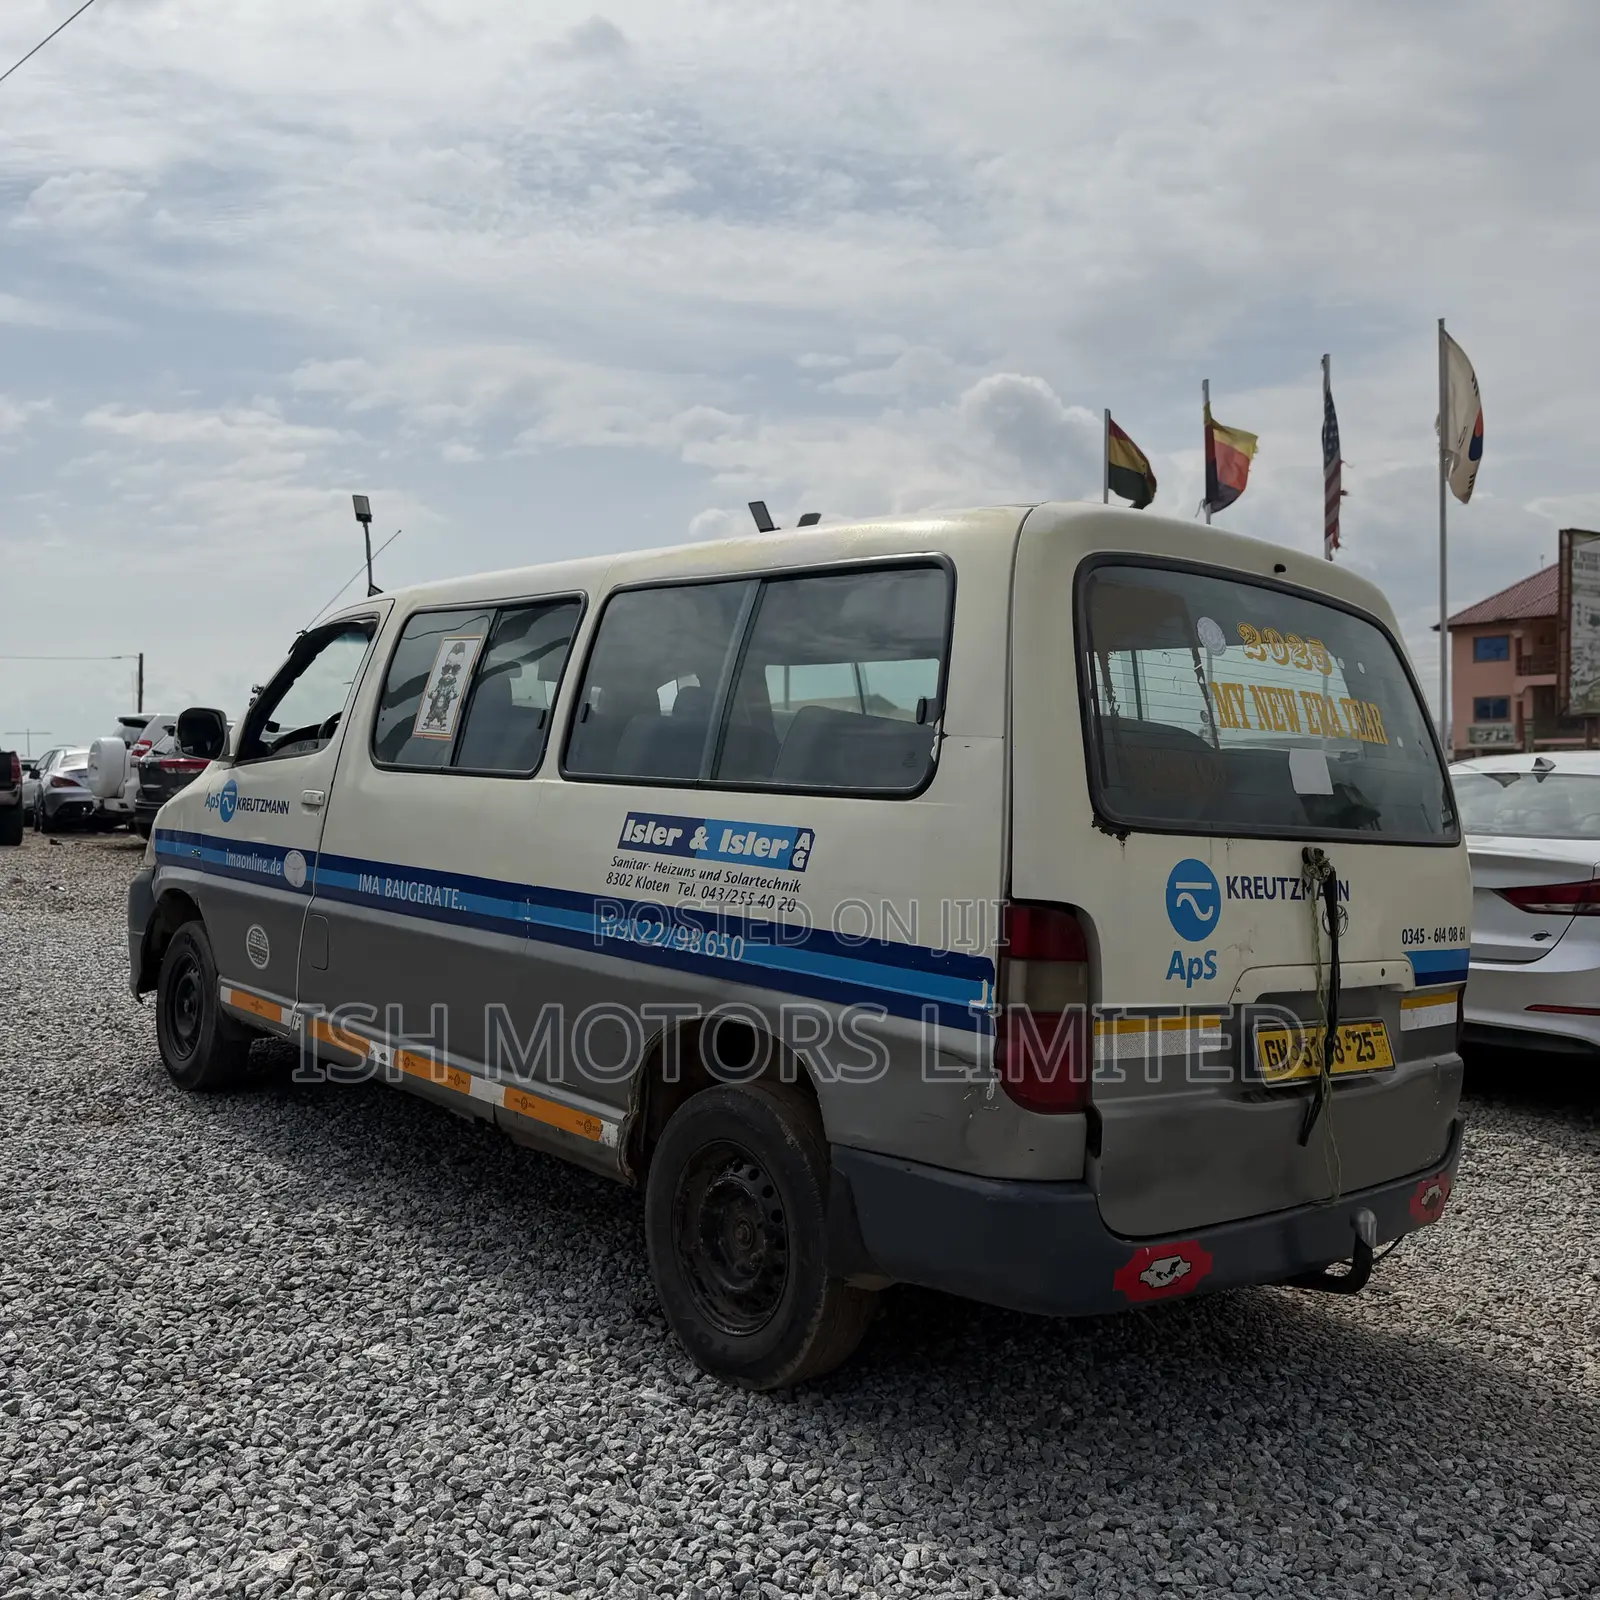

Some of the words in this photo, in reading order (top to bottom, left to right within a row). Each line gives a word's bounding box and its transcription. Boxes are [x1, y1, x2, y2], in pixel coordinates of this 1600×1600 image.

[1237, 621, 1332, 676] 2025
[1210, 682, 1251, 729] MY
[1249, 684, 1300, 733] NEW
[1299, 690, 1347, 738] ERA
[1339, 697, 1388, 745] YEAR
[204, 791, 221, 813] ApS
[237, 796, 290, 816] KREUTZMANN
[621, 819, 684, 847] Isler
[689, 825, 710, 851] &
[718, 828, 790, 859] Isler
[225, 848, 282, 876] imaonline.de
[611, 855, 651, 871] Sanitar-
[653, 861, 697, 878] Heizuns
[698, 869, 723, 882] und
[723, 871, 801, 893] Solartechnik
[358, 873, 380, 896] IMA
[606, 871, 634, 888] 8302
[635, 875, 670, 893] Kloten
[677, 882, 697, 898] Tel.
[701, 885, 755, 906] 043/255
[757, 894, 776, 910] 40
[778, 896, 797, 913] 20
[1225, 875, 1350, 902] KREUTZMAN
[1401, 927, 1425, 945] 0345
[1433, 926, 1447, 944] 614
[1448, 926, 1458, 943] 08
[1166, 950, 1217, 989] ApS
